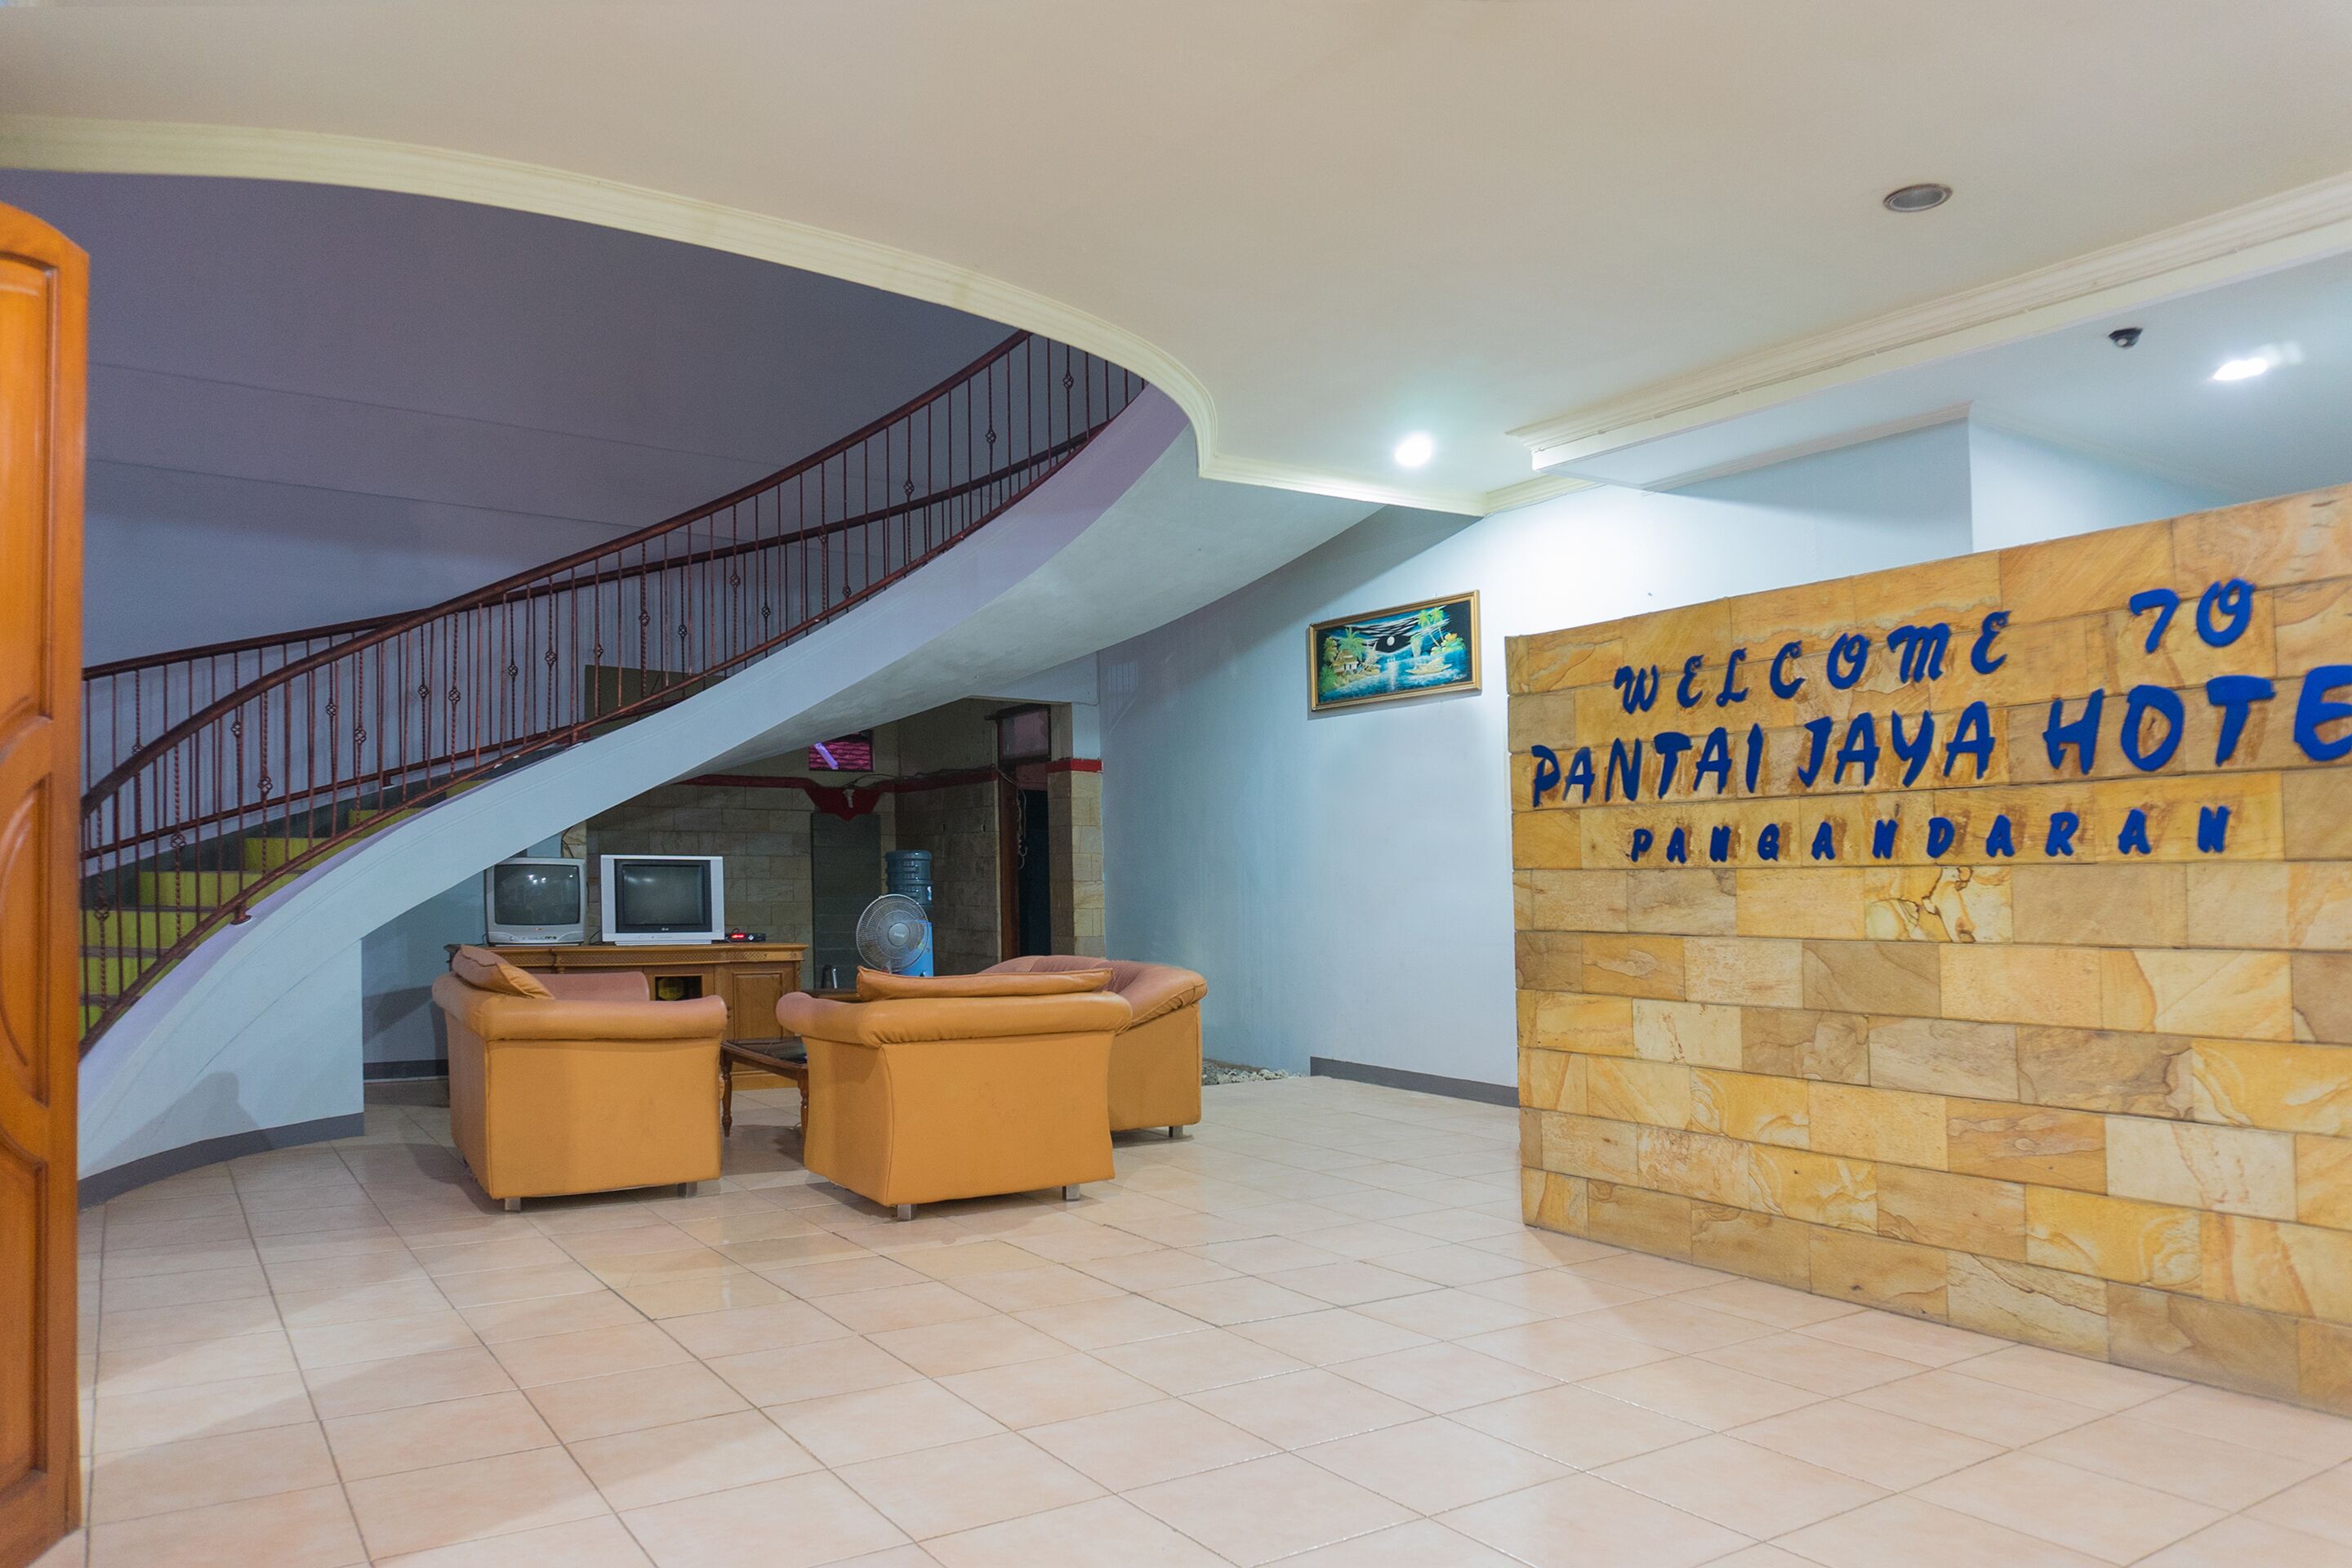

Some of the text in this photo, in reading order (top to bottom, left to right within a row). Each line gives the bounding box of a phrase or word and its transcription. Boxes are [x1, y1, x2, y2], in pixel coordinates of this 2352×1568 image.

[1614, 611, 2011, 715] WELCOME
[1531, 723, 1764, 806] PANTAI
[1797, 700, 1996, 788] JAYA
[1630, 805, 2231, 863] PANGANDARAN
